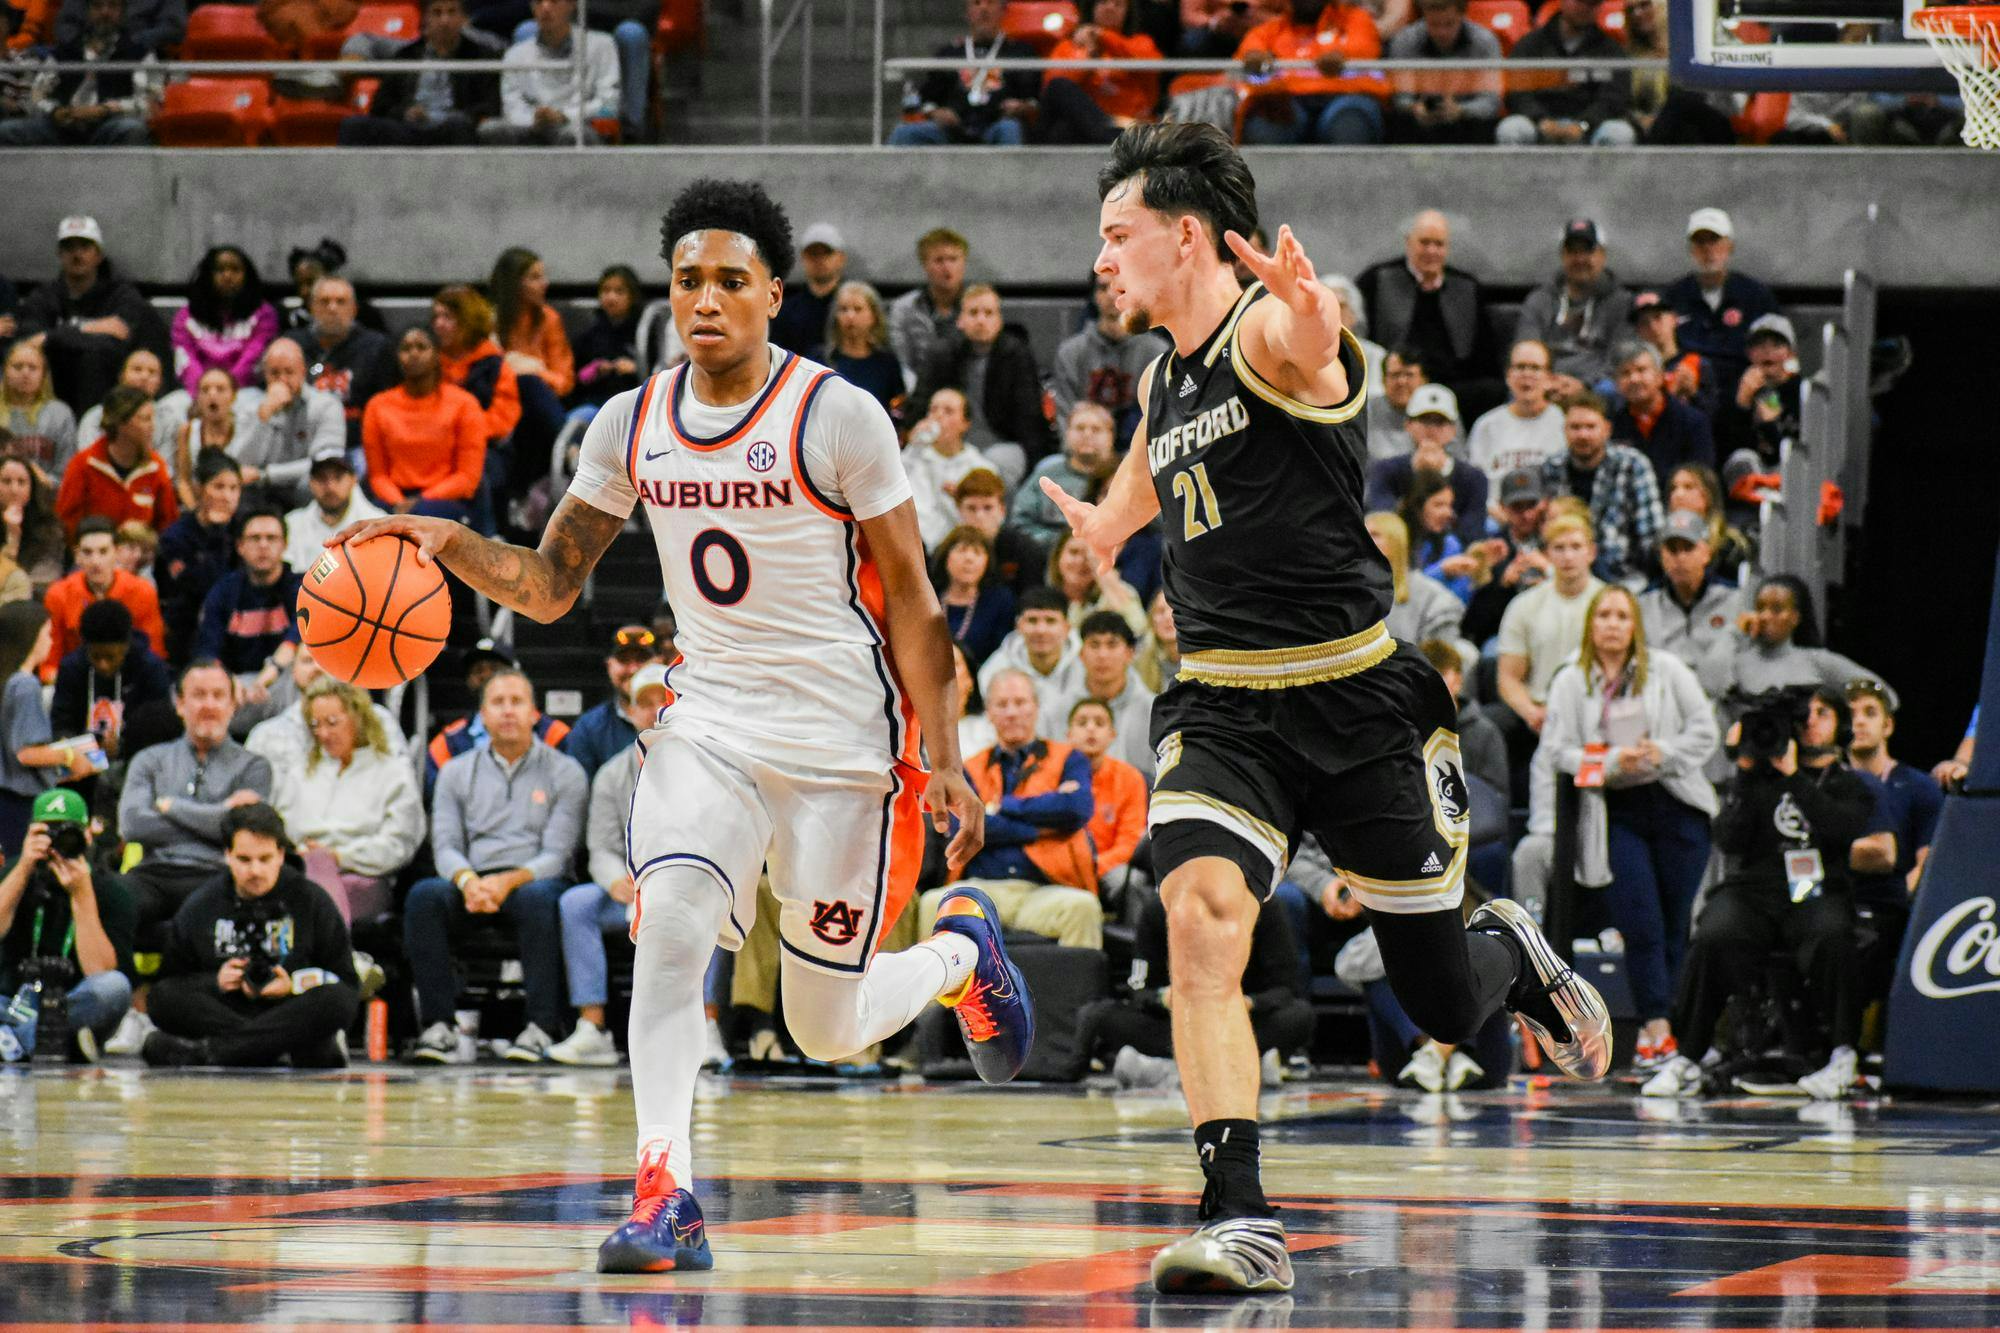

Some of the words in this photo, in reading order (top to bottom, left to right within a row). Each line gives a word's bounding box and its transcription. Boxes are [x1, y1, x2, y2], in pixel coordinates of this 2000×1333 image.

[748, 442, 776, 471] SEC
[638, 478, 794, 509] AUBURN
[1172, 461, 1223, 542] 21
[690, 527, 752, 608] 0
[1420, 864, 1444, 873] adidas
